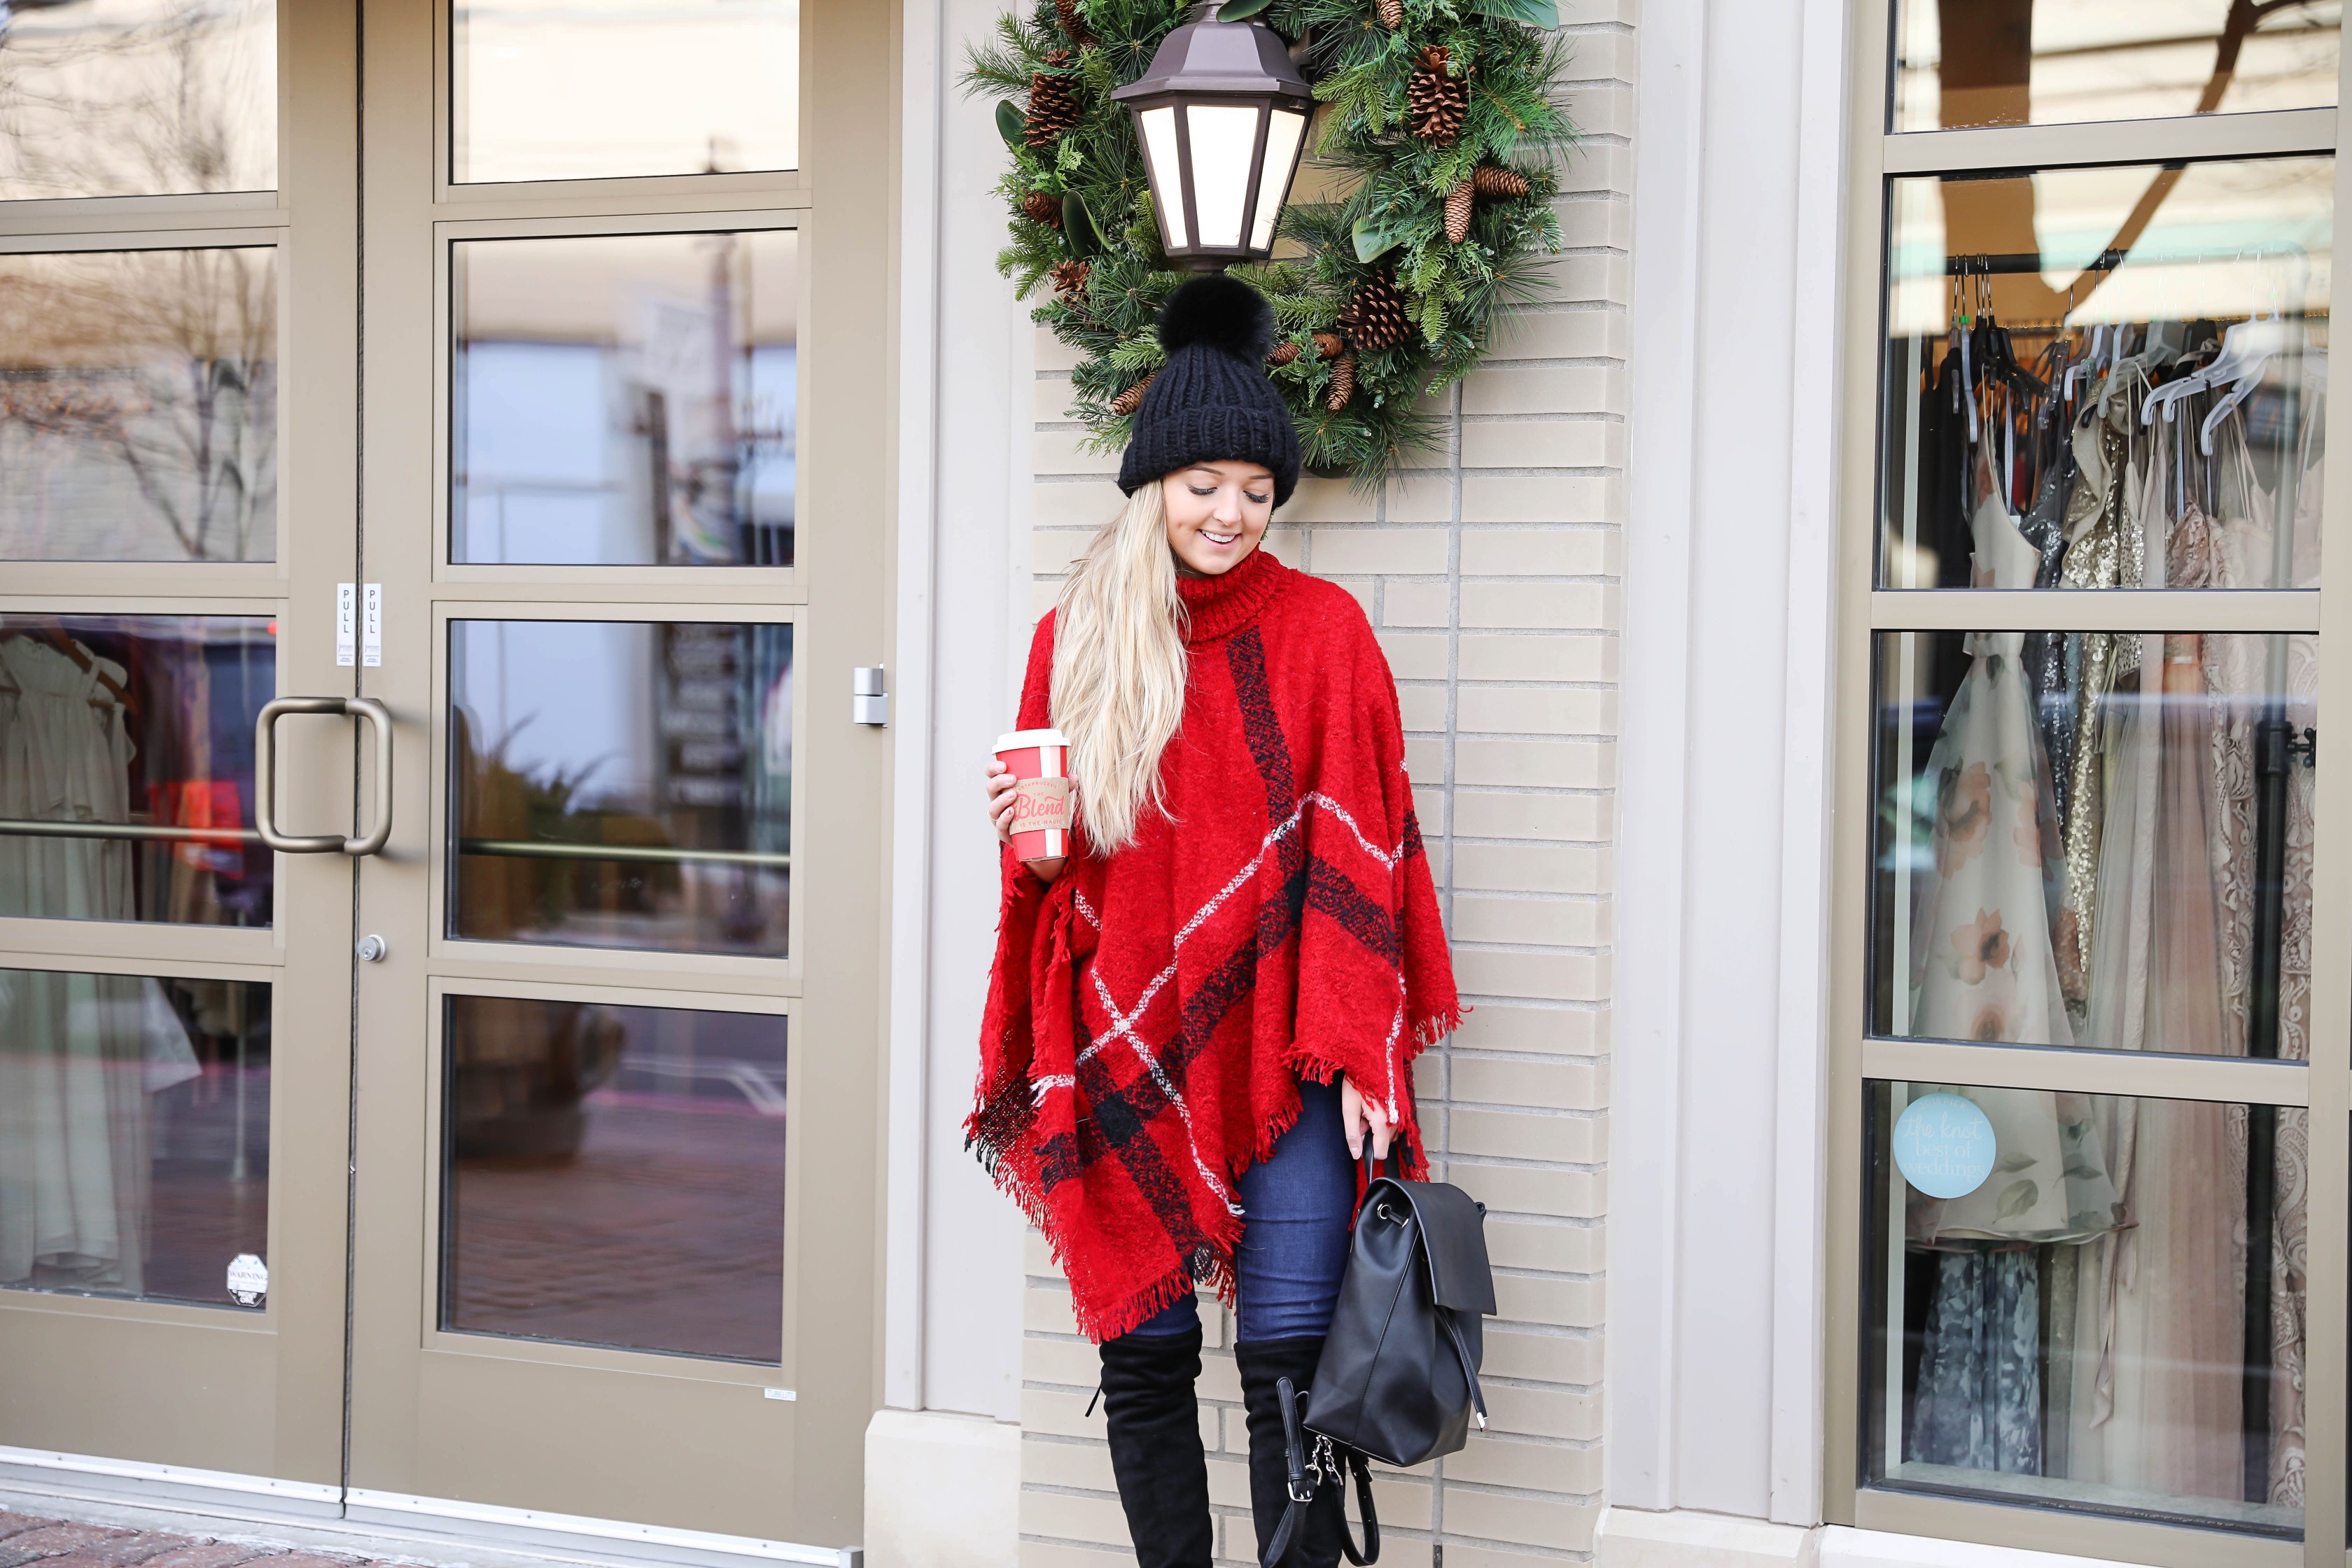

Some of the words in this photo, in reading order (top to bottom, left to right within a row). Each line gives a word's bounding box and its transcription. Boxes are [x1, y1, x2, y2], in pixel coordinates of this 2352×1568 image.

[1014, 794, 1064, 822] Blend
[1919, 1098, 1940, 1109] 2018
[1943, 1097, 1966, 1110] PICK
[1902, 1113, 1935, 1138] the
[1940, 1110, 1983, 1140] knot
[1915, 1138, 1950, 1157] best
[1954, 1140, 1973, 1158] of
[1902, 1157, 1985, 1184] weddings
[229, 1270, 268, 1281] WARNING
